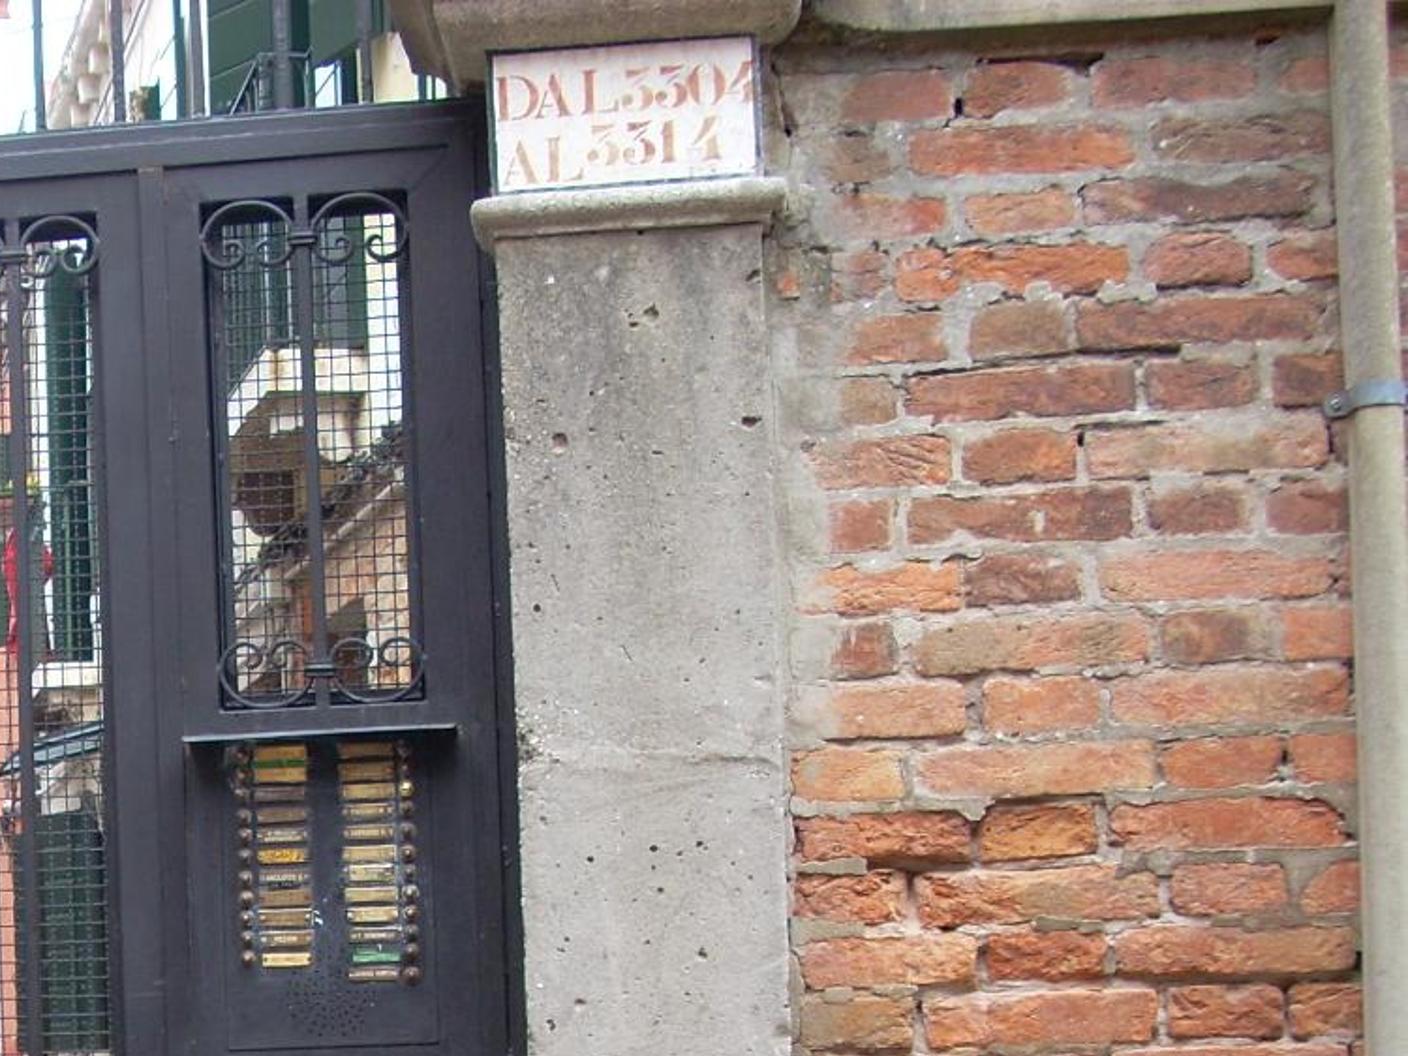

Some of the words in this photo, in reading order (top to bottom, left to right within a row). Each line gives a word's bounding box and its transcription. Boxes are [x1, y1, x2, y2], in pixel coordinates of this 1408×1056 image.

[497, 68, 619, 122] DAL
[620, 59, 754, 108] 3304
[504, 136, 584, 185] AL
[586, 116, 722, 167] 3314
